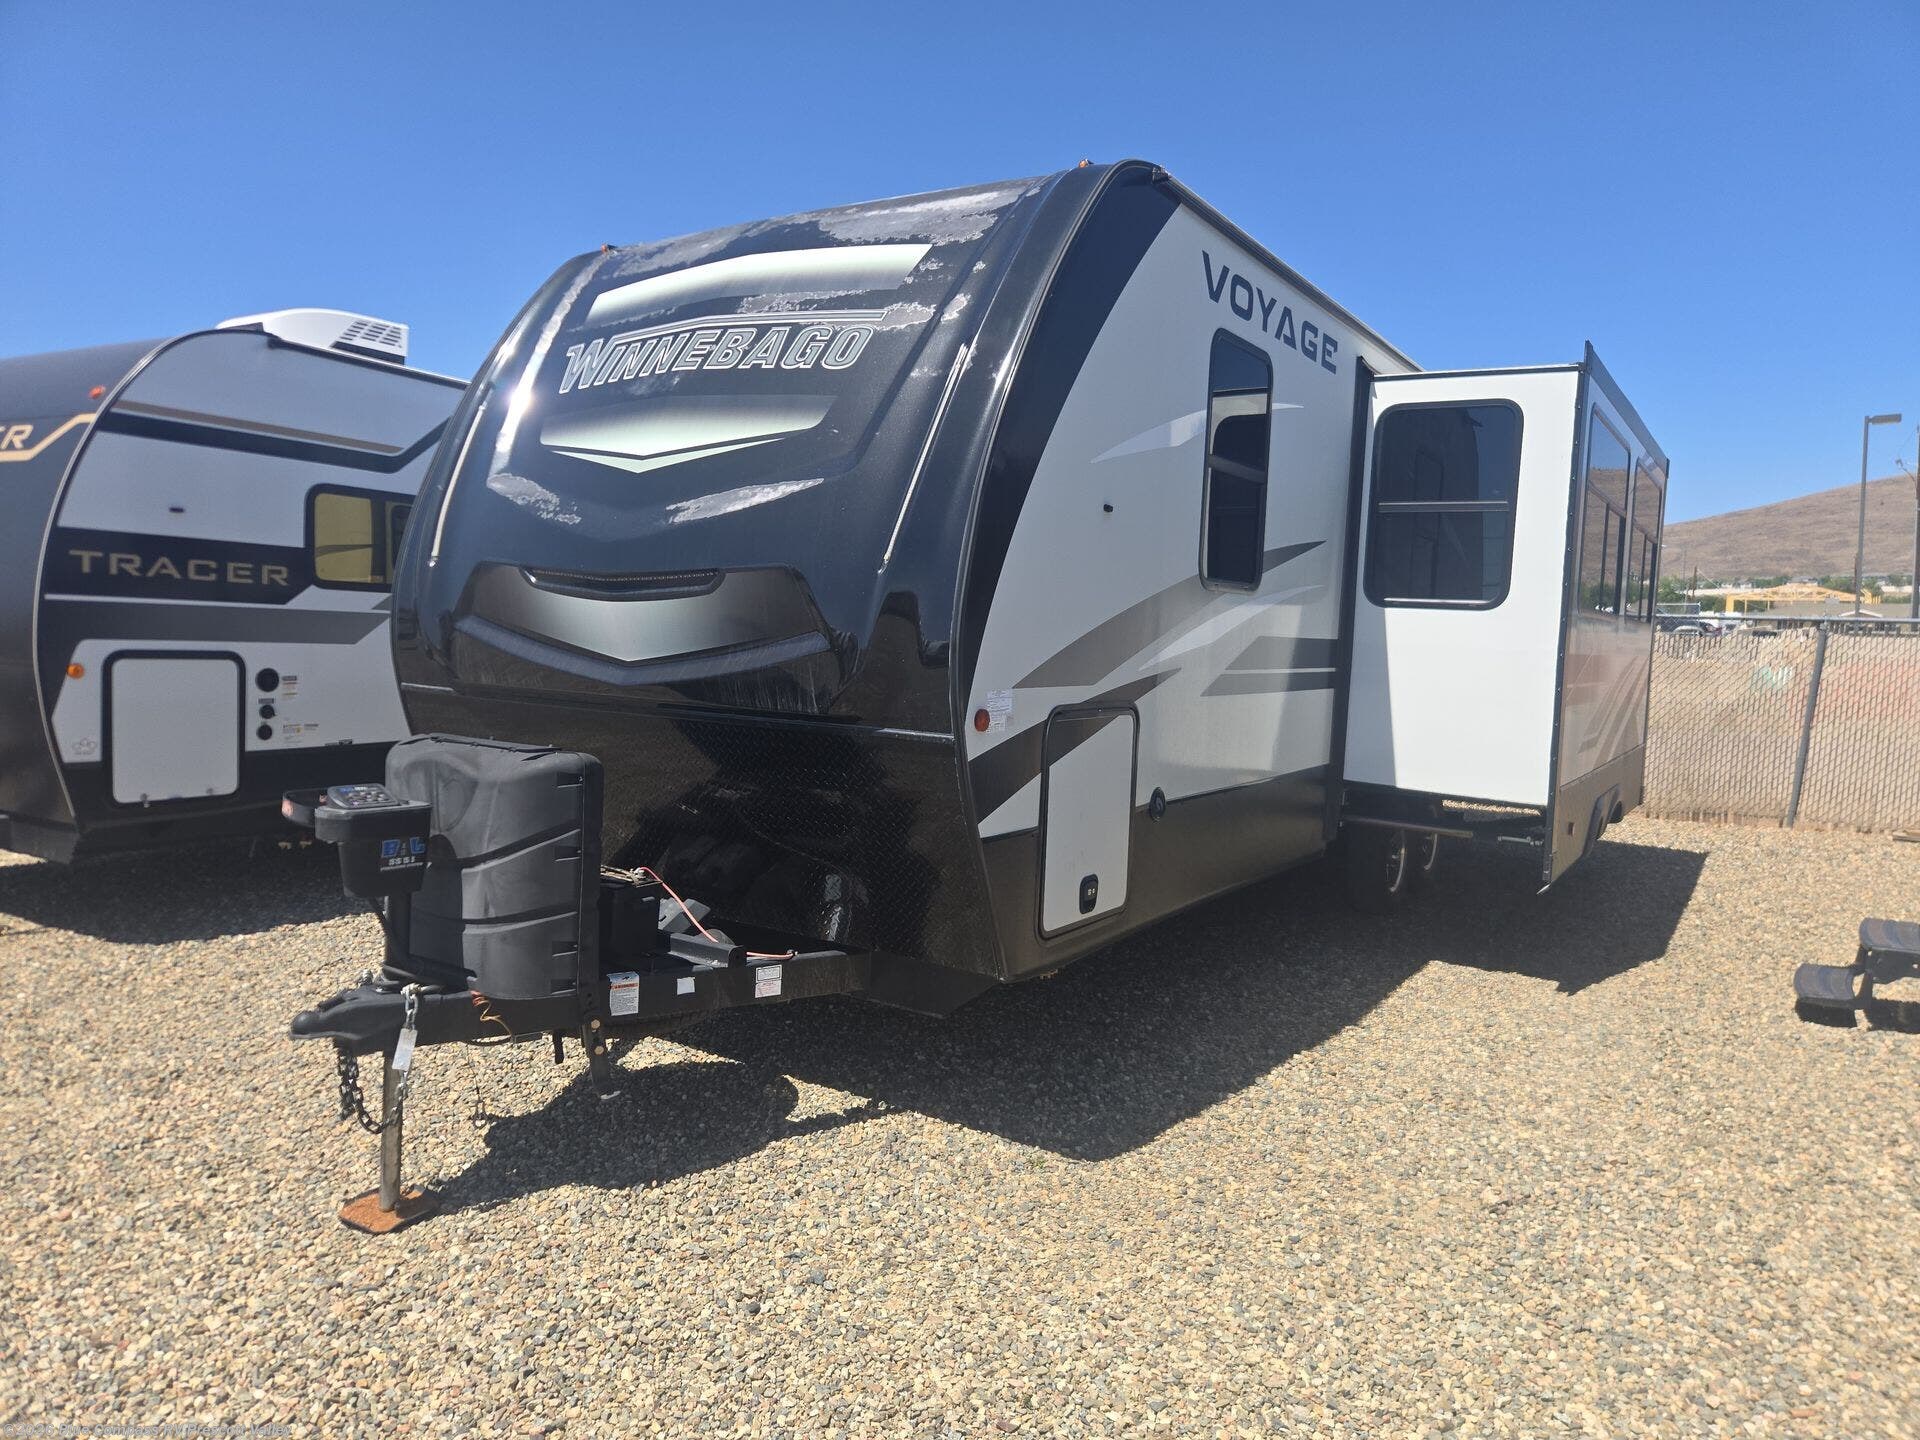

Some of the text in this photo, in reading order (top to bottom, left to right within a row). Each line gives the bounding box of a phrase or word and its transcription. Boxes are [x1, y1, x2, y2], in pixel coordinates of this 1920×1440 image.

[1202, 250, 1338, 375] VOYAGE
[558, 321, 878, 395] WINNEBAGO
[69, 549, 290, 586] TRACER
